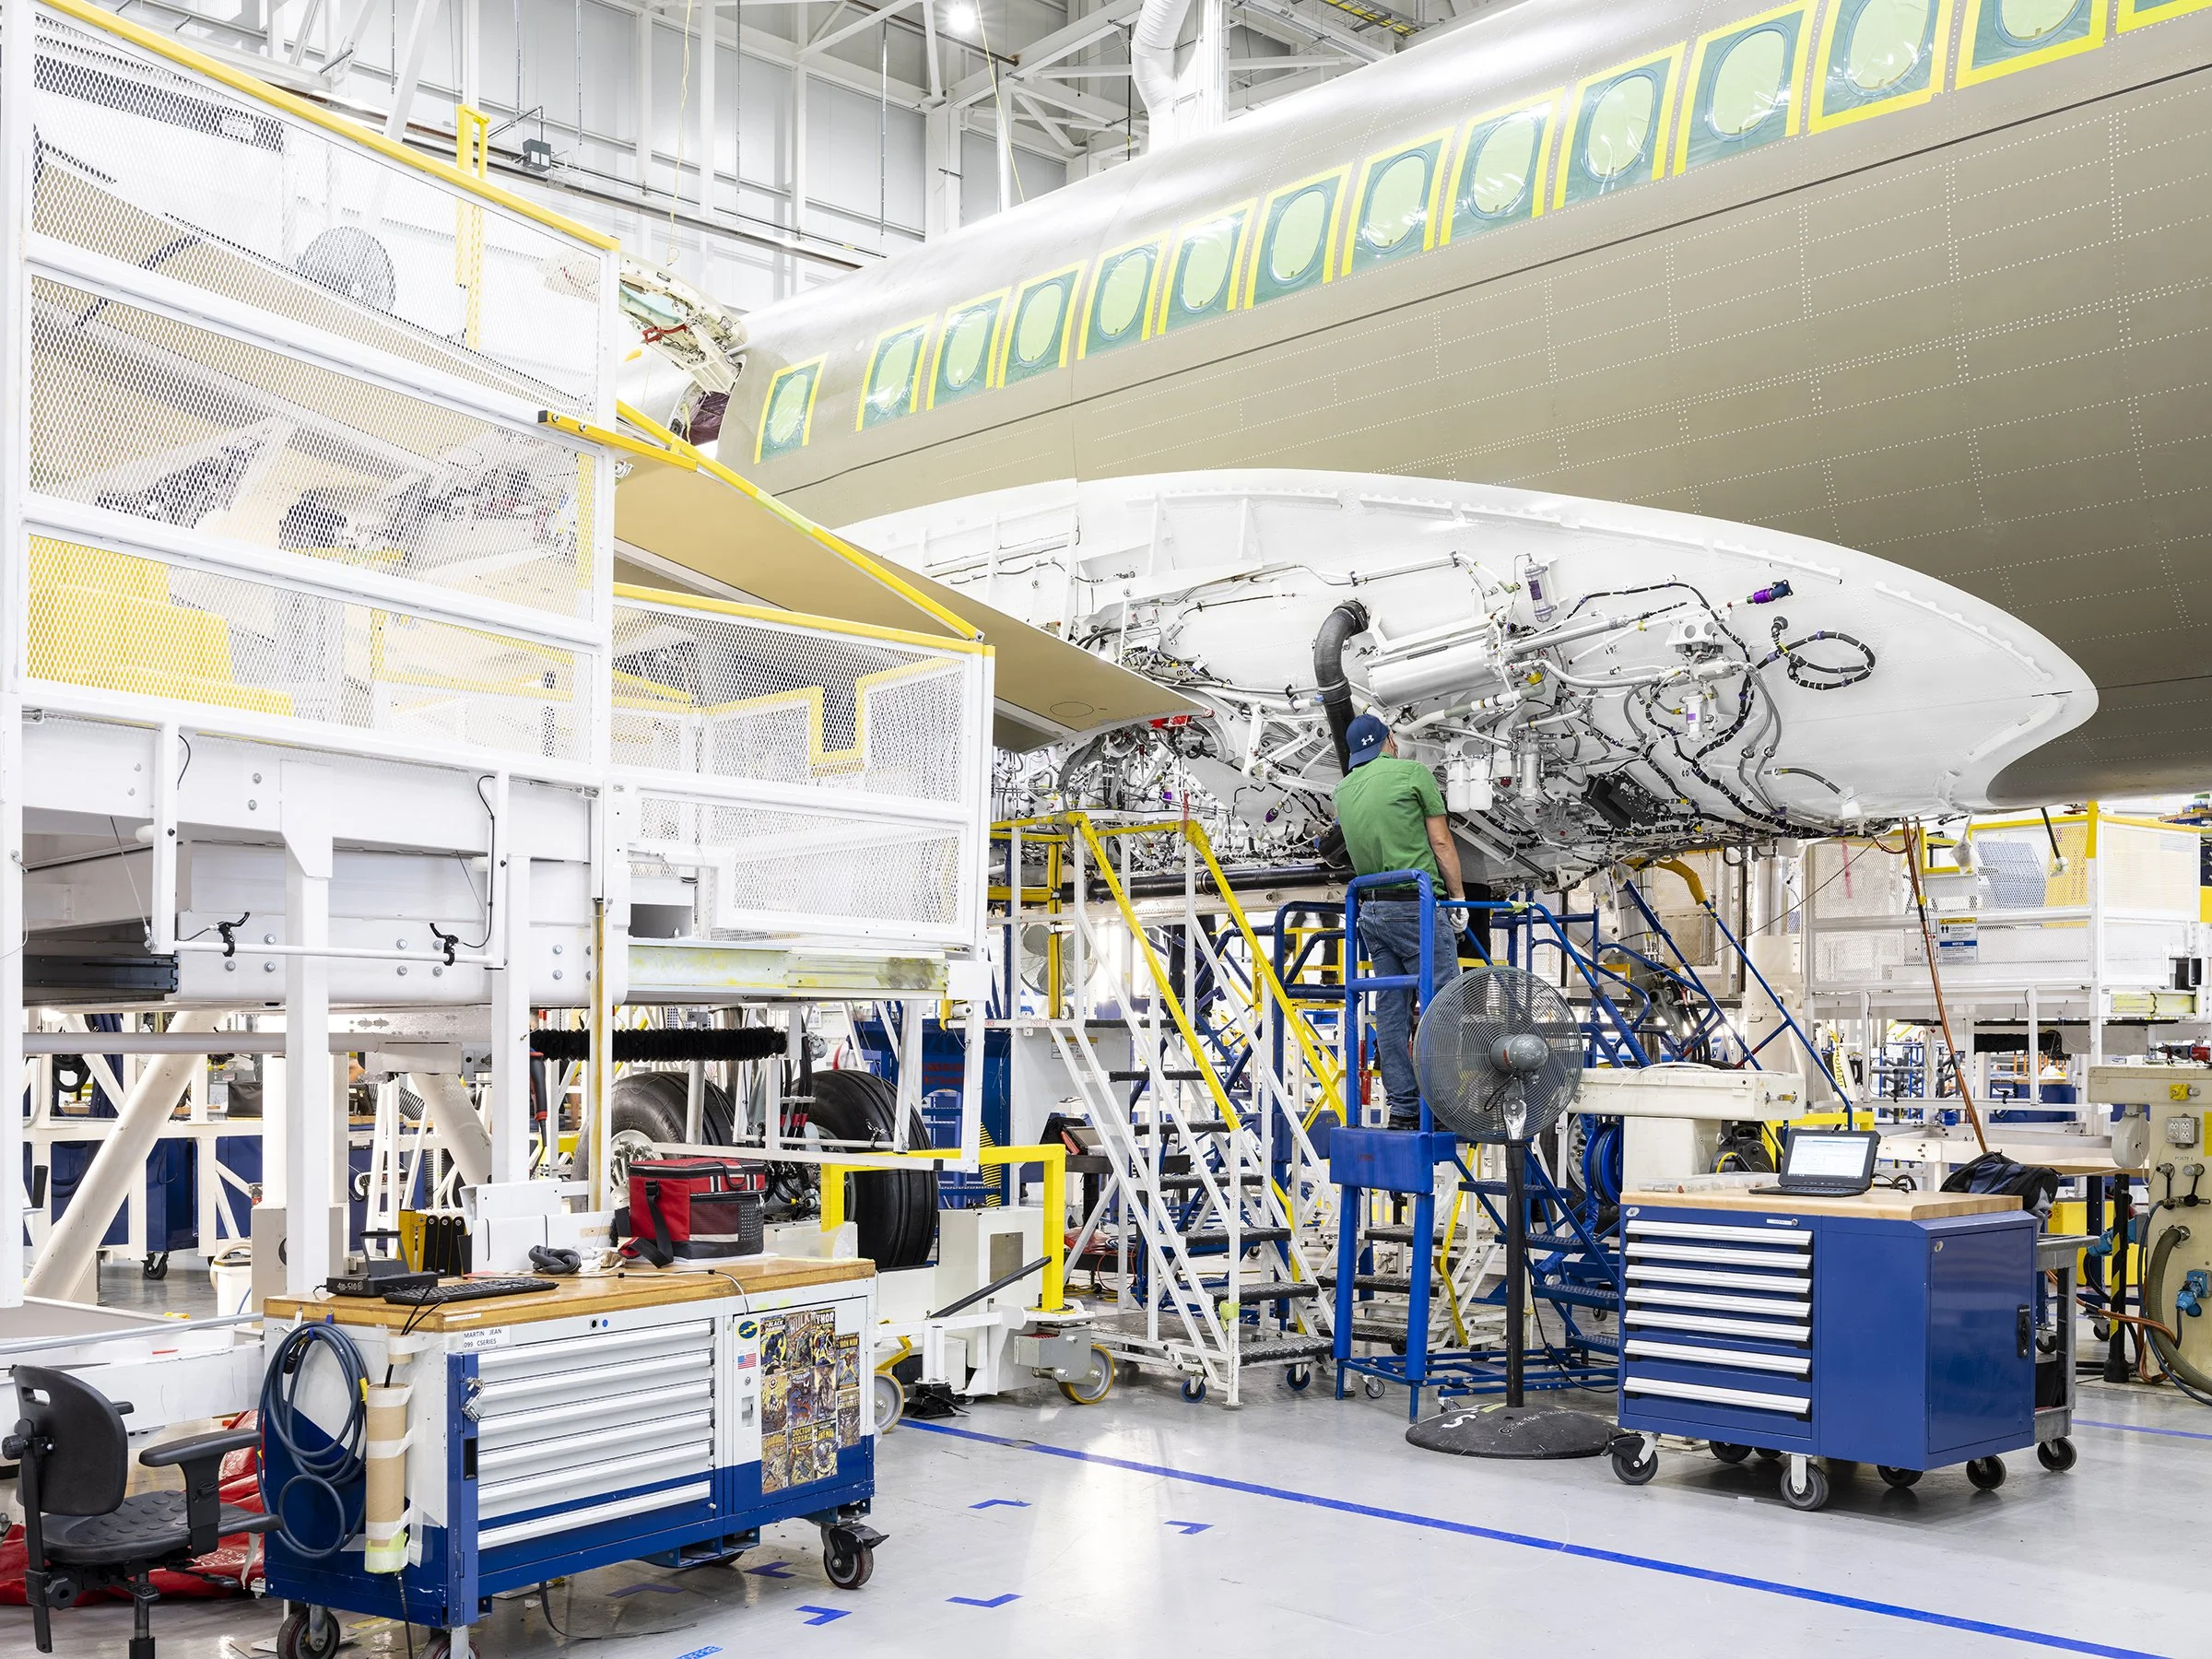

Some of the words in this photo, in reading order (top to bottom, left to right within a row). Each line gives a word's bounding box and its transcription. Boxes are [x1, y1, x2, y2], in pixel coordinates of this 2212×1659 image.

[789, 1312, 810, 1335] HULK
[816, 1312, 834, 1324] THOR
[477, 1338, 497, 1347] CSERIES
[792, 1426, 811, 1437] DOCTOR
